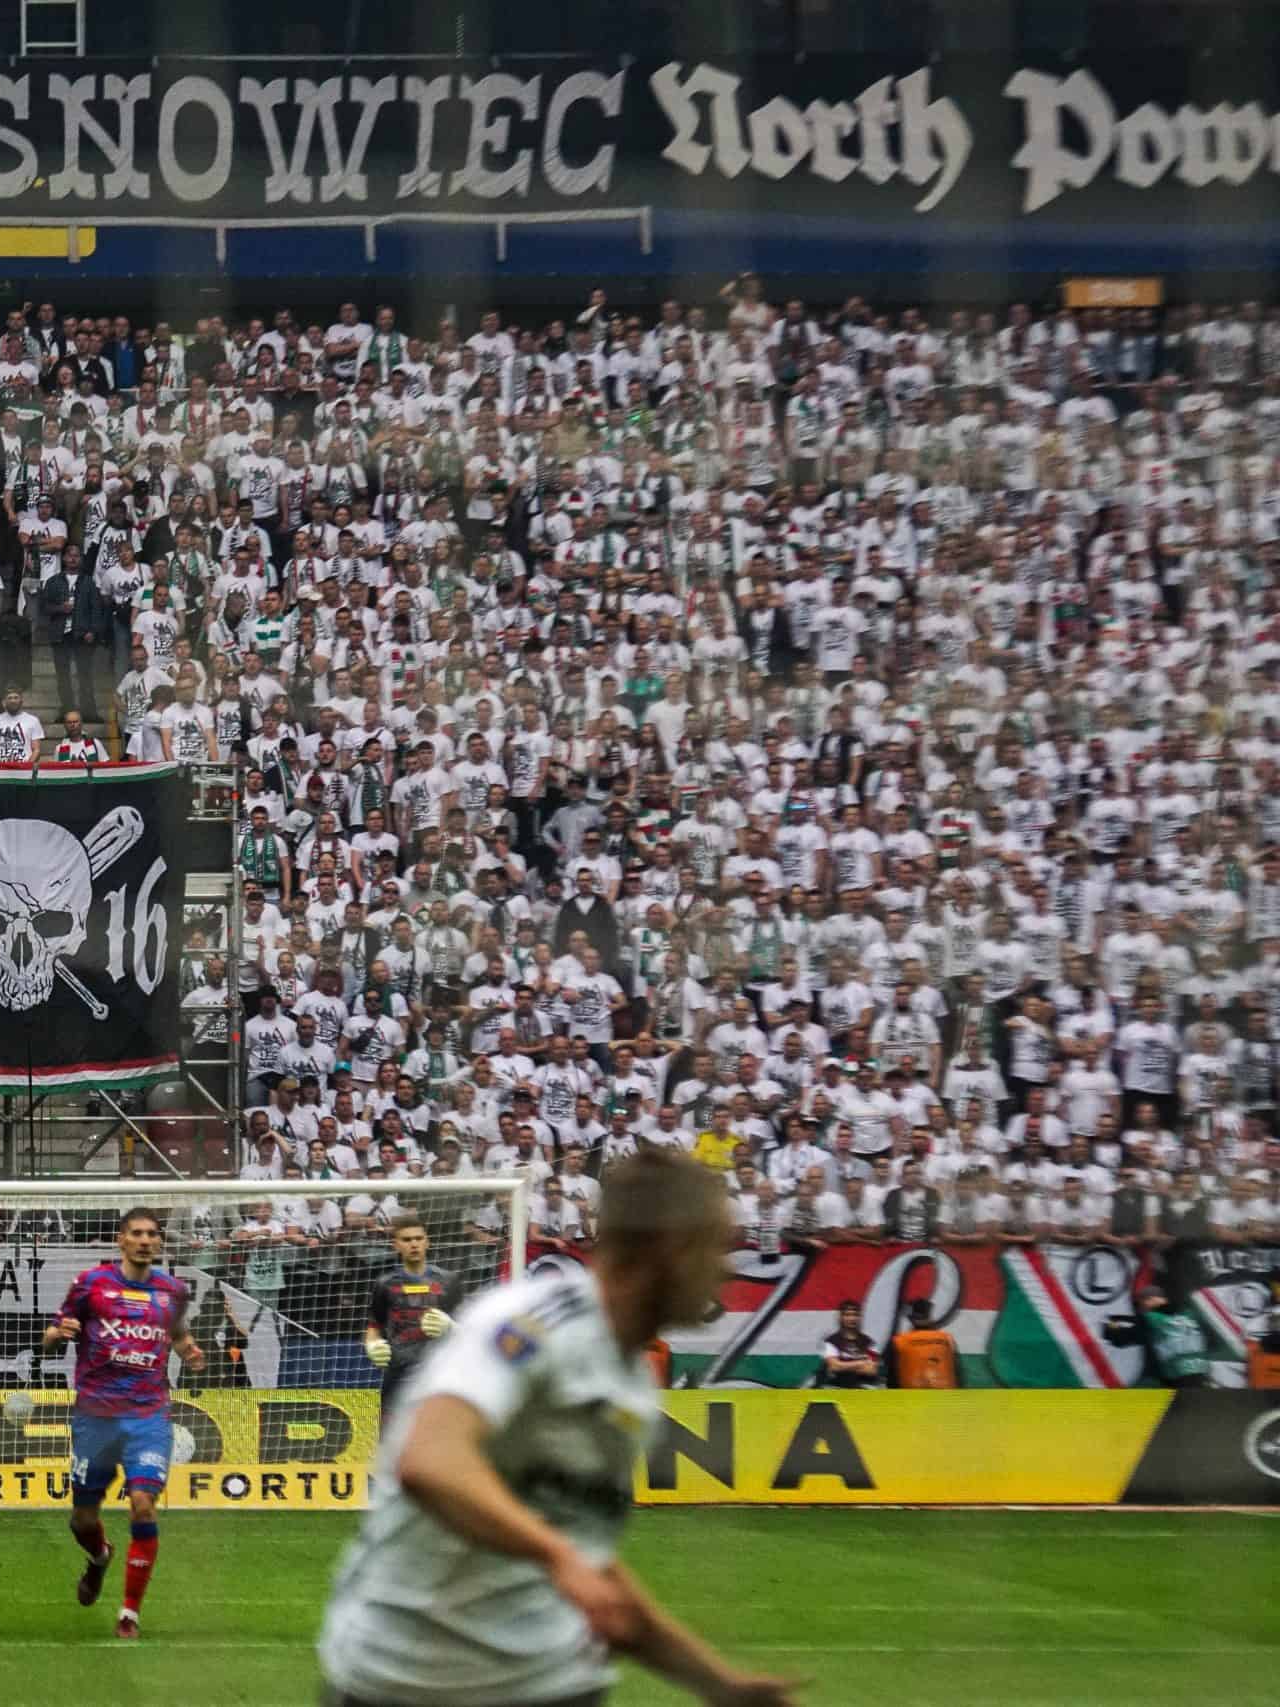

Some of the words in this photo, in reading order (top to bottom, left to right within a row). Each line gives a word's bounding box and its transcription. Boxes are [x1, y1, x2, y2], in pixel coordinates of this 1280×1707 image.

[649, 61, 974, 213] North
[1001, 67, 1280, 214] Pow
[104, 856, 169, 996] 16
[189, 1472, 374, 1501] FORTU
